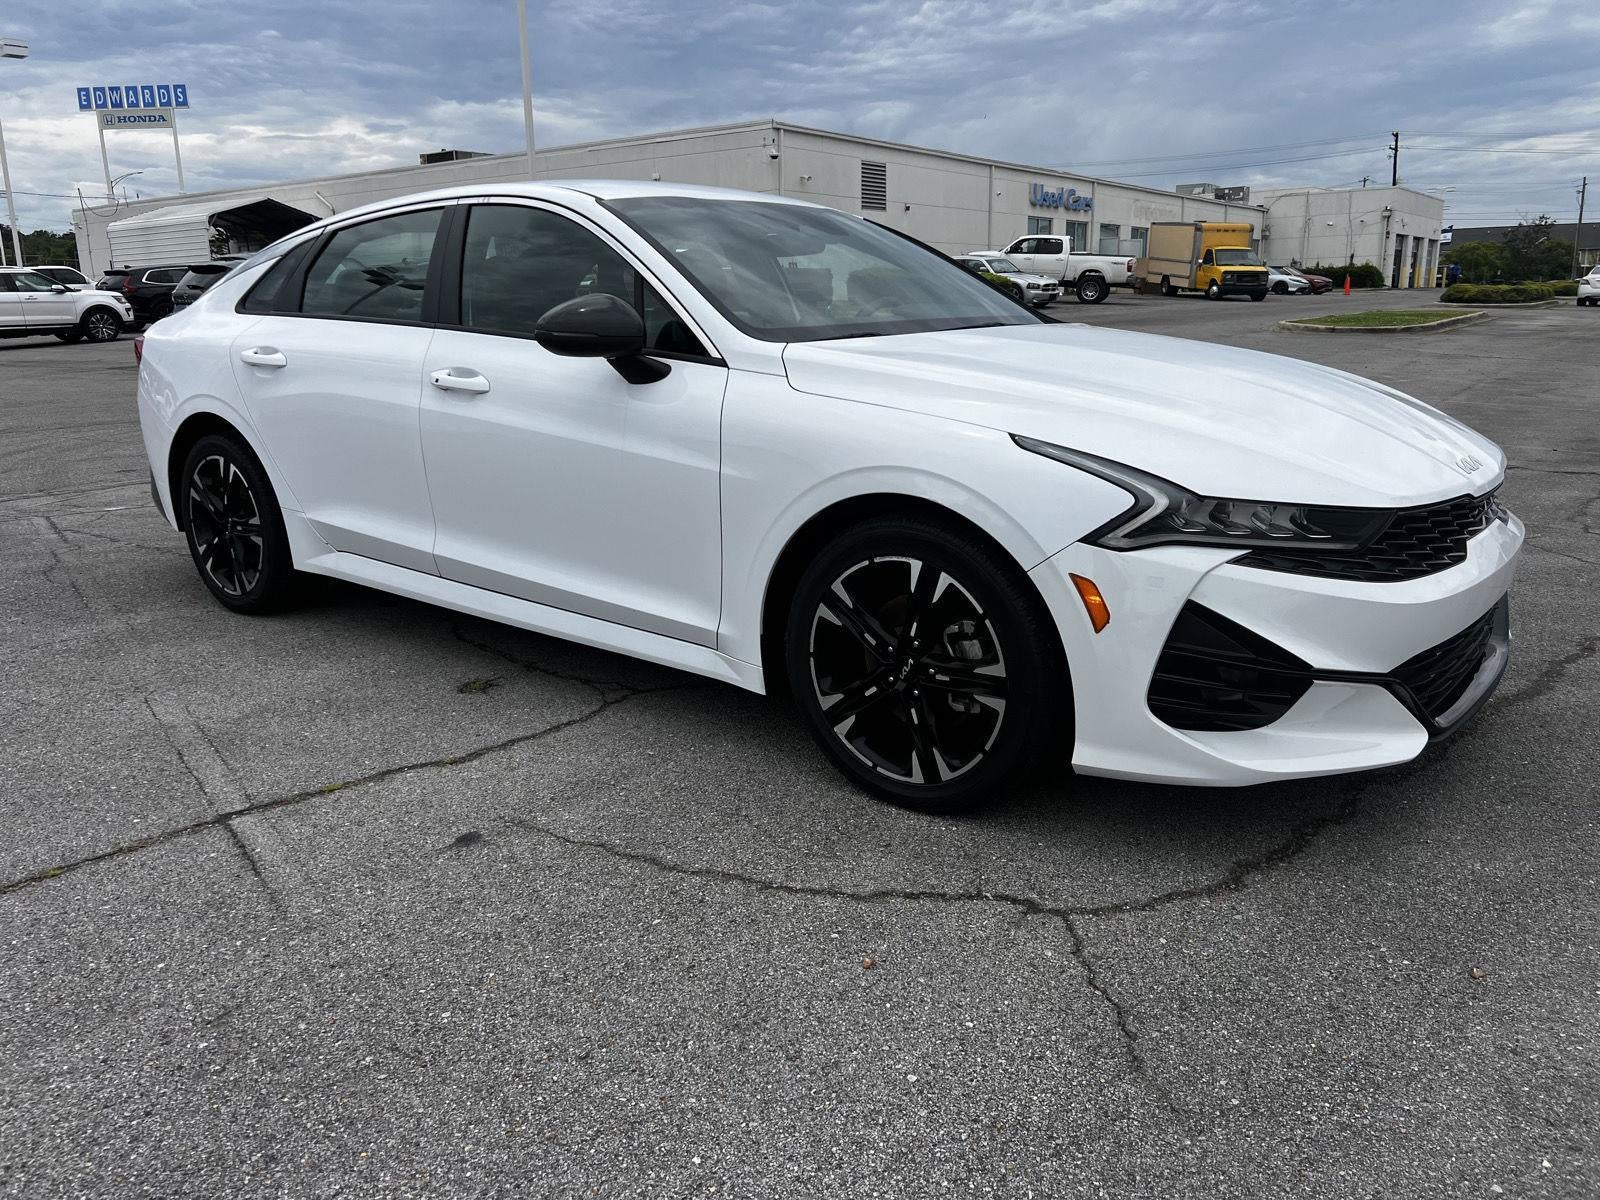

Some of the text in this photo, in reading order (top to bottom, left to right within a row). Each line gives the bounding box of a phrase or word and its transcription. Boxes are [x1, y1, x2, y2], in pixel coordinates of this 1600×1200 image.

[80, 86, 185, 106] EDWARDS
[117, 114, 167, 124] HONDA
[1029, 183, 1065, 209] Used
